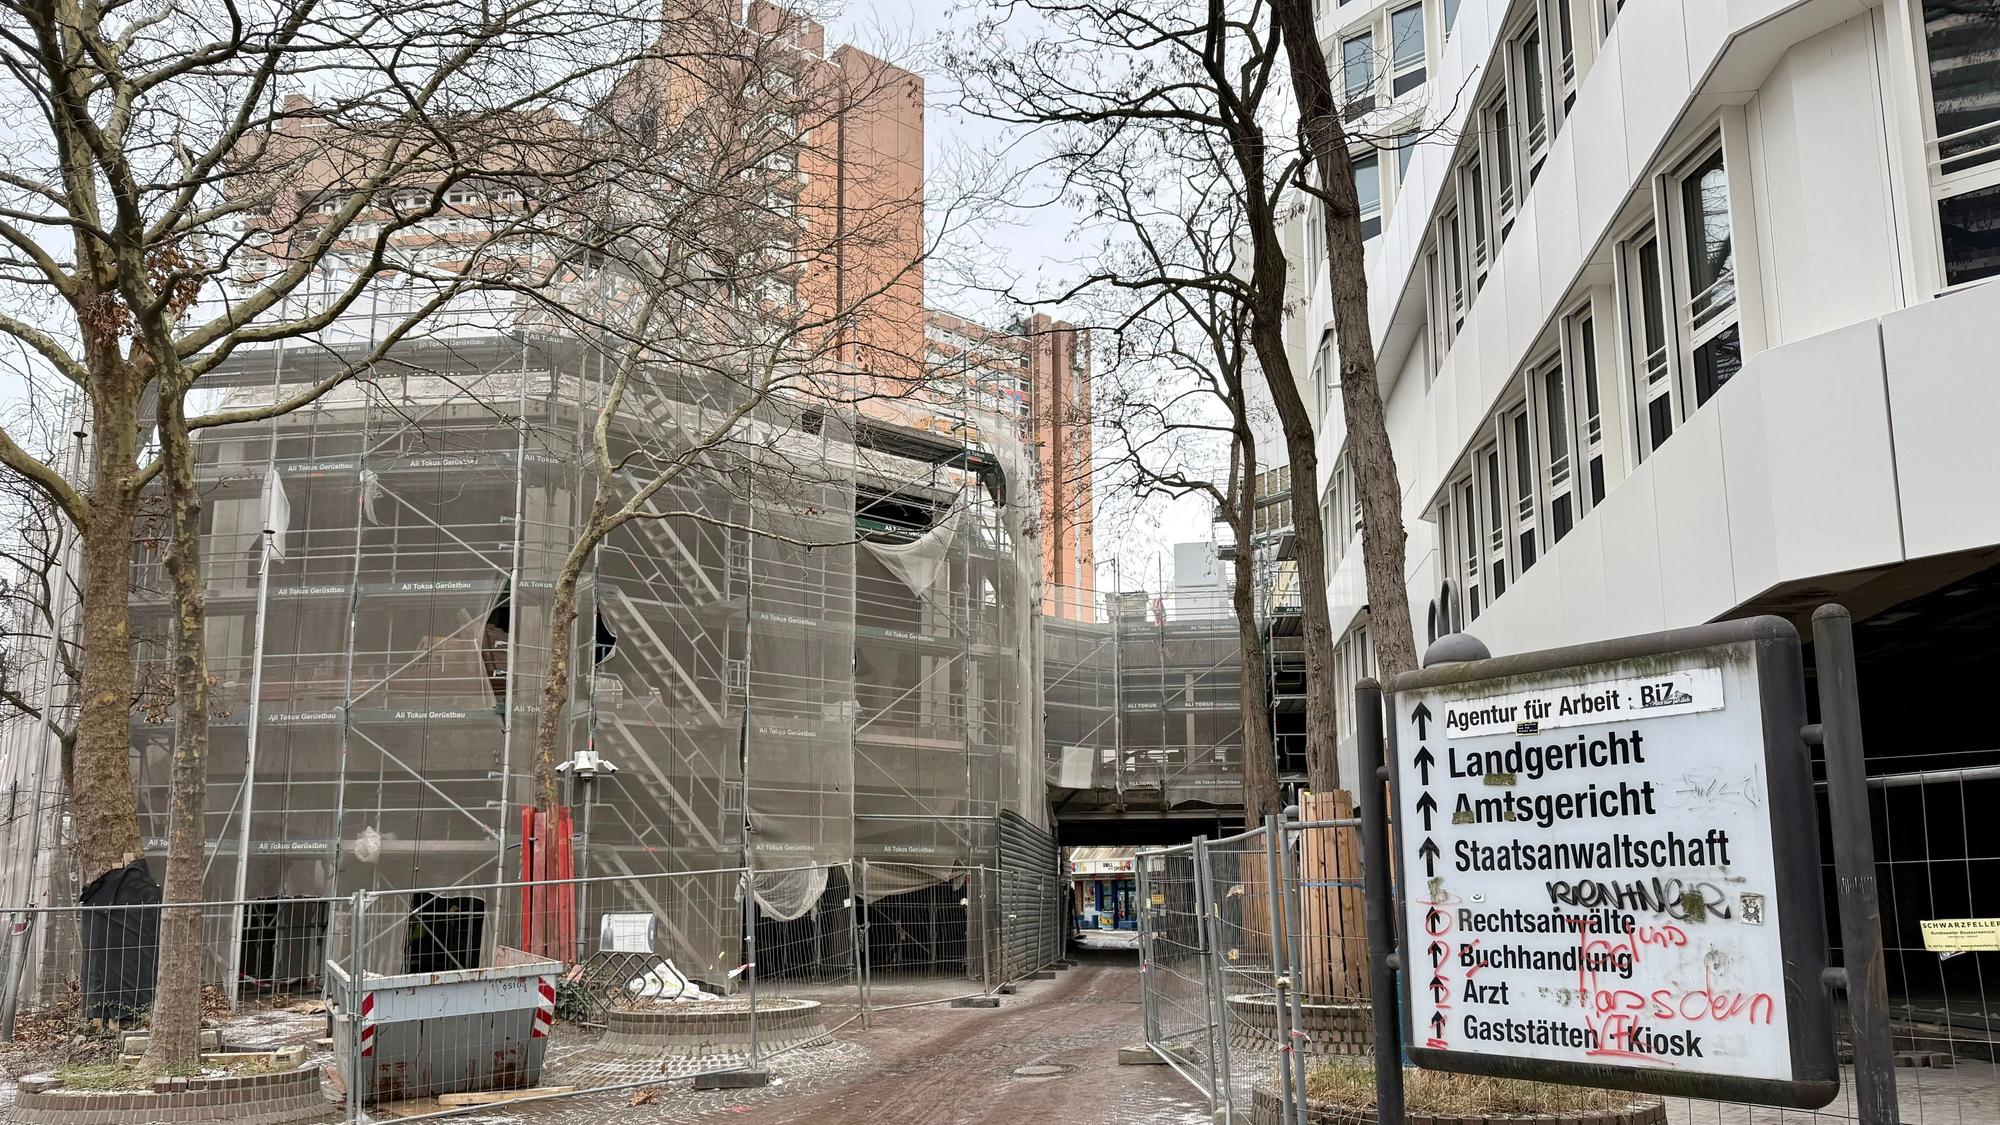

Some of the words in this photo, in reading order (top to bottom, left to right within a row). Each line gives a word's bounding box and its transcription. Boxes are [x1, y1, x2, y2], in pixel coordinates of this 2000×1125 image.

[541, 335, 563, 343] Tokus
[536, 456, 559, 464] Tokus
[770, 614, 787, 622] Tokus
[893, 631, 908, 639] Tokus
[1446, 704, 1518, 732] Agentur
[1524, 699, 1552, 720] für
[1559, 690, 1620, 716] Arbeit
[1640, 682, 1674, 706] BiZ
[1448, 730, 1645, 780] Landgericht
[1452, 781, 1656, 828] Amtsgericht
[1454, 829, 1731, 872] Staatsanwaltschaft
[1458, 907, 1636, 934] Rechtsanwälte
[1460, 943, 1633, 978] Buchhandlung
[1463, 978, 1509, 1006] Arzt
[1463, 1014, 1598, 1050] Gaststätten
[1627, 1025, 1703, 1058] Kiosk
